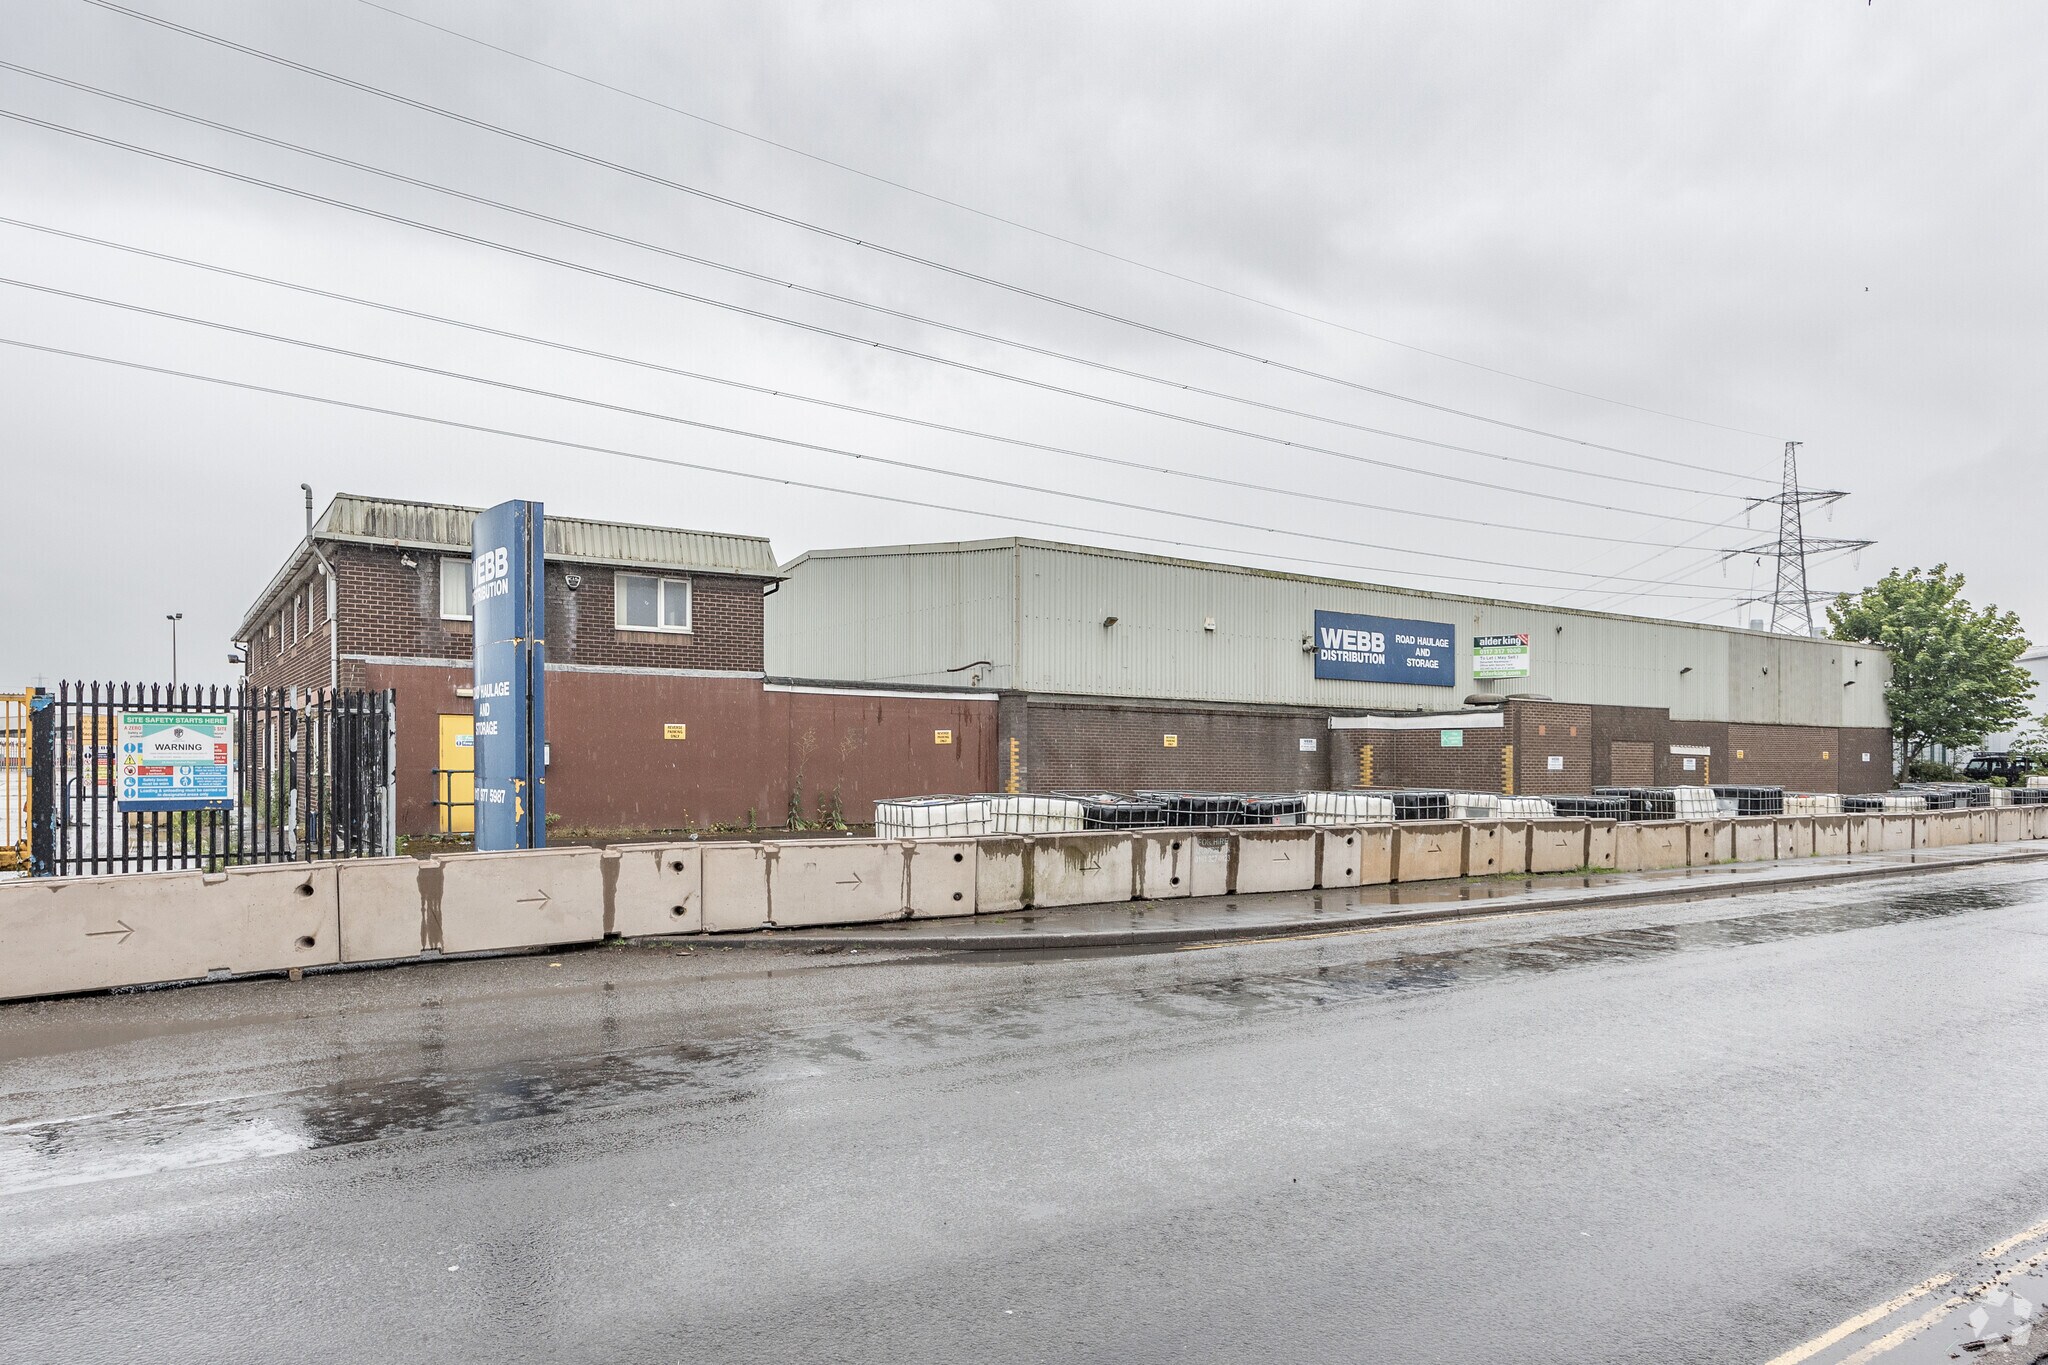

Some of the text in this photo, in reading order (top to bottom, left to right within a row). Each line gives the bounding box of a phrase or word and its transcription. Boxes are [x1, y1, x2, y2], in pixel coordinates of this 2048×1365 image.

[1320, 627, 1386, 653] WEBB
[1395, 634, 1450, 648] ROAD HAULAGE
[1321, 649, 1386, 665] DISTRIBUTION
[1415, 647, 1431, 657] AND
[1406, 658, 1440, 669] STORAGE
[480, 681, 509, 698] HAULAGE
[479, 702, 490, 717] AND
[475, 720, 498, 736] STORAGE
[489, 789, 506, 804] 5987
